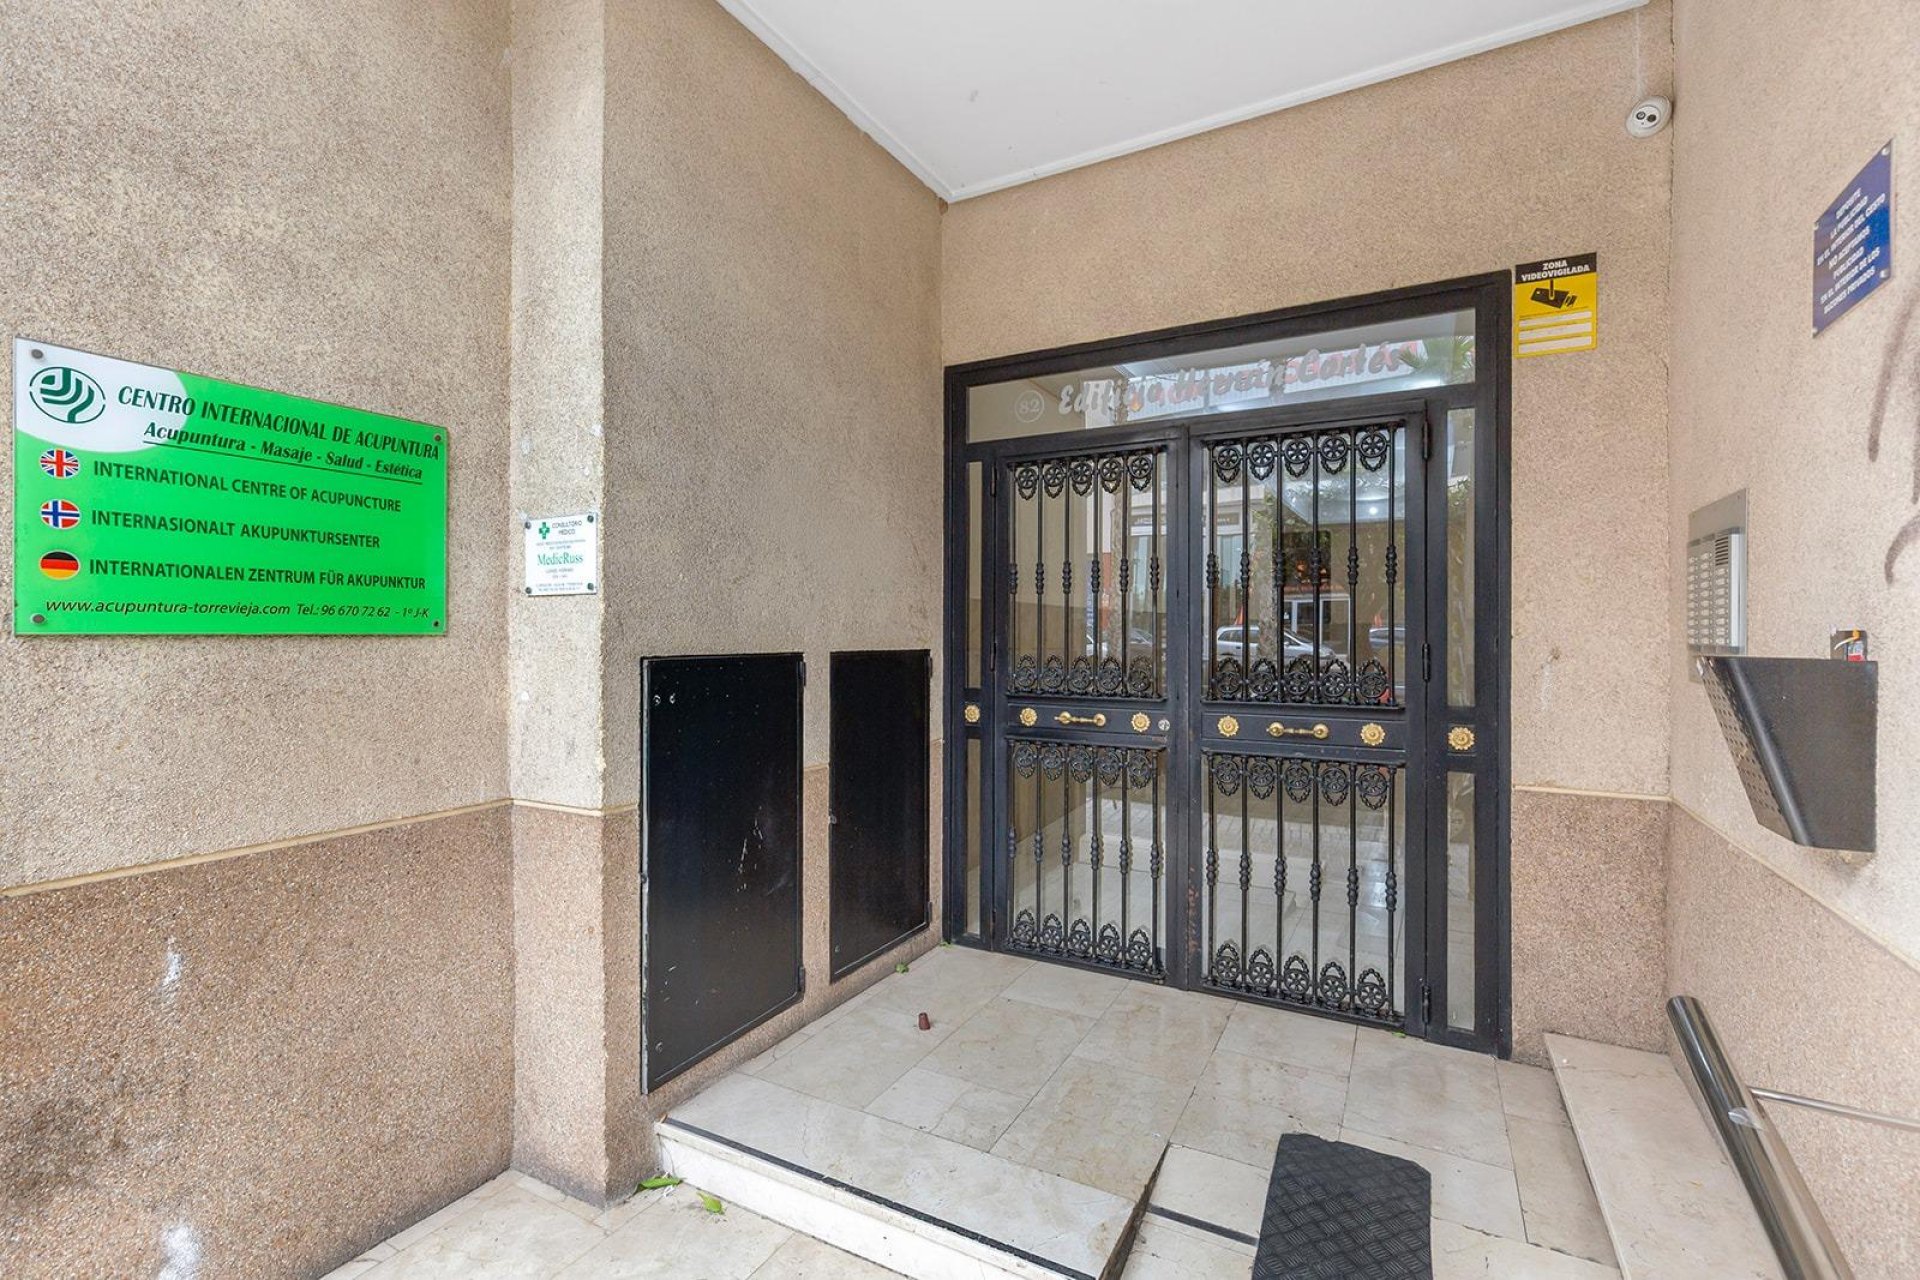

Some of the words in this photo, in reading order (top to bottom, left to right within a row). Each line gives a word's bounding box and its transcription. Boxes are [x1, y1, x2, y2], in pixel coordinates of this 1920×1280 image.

[1521, 264, 1591, 282] VIDEOVIGILADA
[1542, 259, 1568, 271] ZONA
[1829, 254, 1838, 270] NO
[118, 385, 196, 416] CENTRO
[201, 401, 328, 440] INTERNACIONAL
[332, 426, 352, 445] DE
[355, 431, 439, 460] ACUPUNTURA
[143, 421, 246, 451] Acupuntura
[260, 440, 313, 463] Masaje
[325, 450, 364, 469] Salud
[375, 459, 423, 479] Estética
[94, 460, 228, 491] INTERNATIONAL
[232, 479, 286, 498] CENTRE
[289, 486, 307, 500] OF
[311, 489, 402, 512] ACUPUNCTURE
[91, 509, 236, 536] INTERNASIONALT
[240, 523, 380, 549] AKUPUNKTURSENTER
[537, 551, 584, 566] MedicRuss
[89, 559, 245, 581] INTERNATIONALEN
[249, 567, 315, 585] ZENTRUM
[319, 568, 344, 586] FÜR
[347, 574, 426, 590] AKUPUNKTUR
[46, 600, 291, 617] www.acupuntura-torrevieja.com
[337, 605, 359, 617] 670
